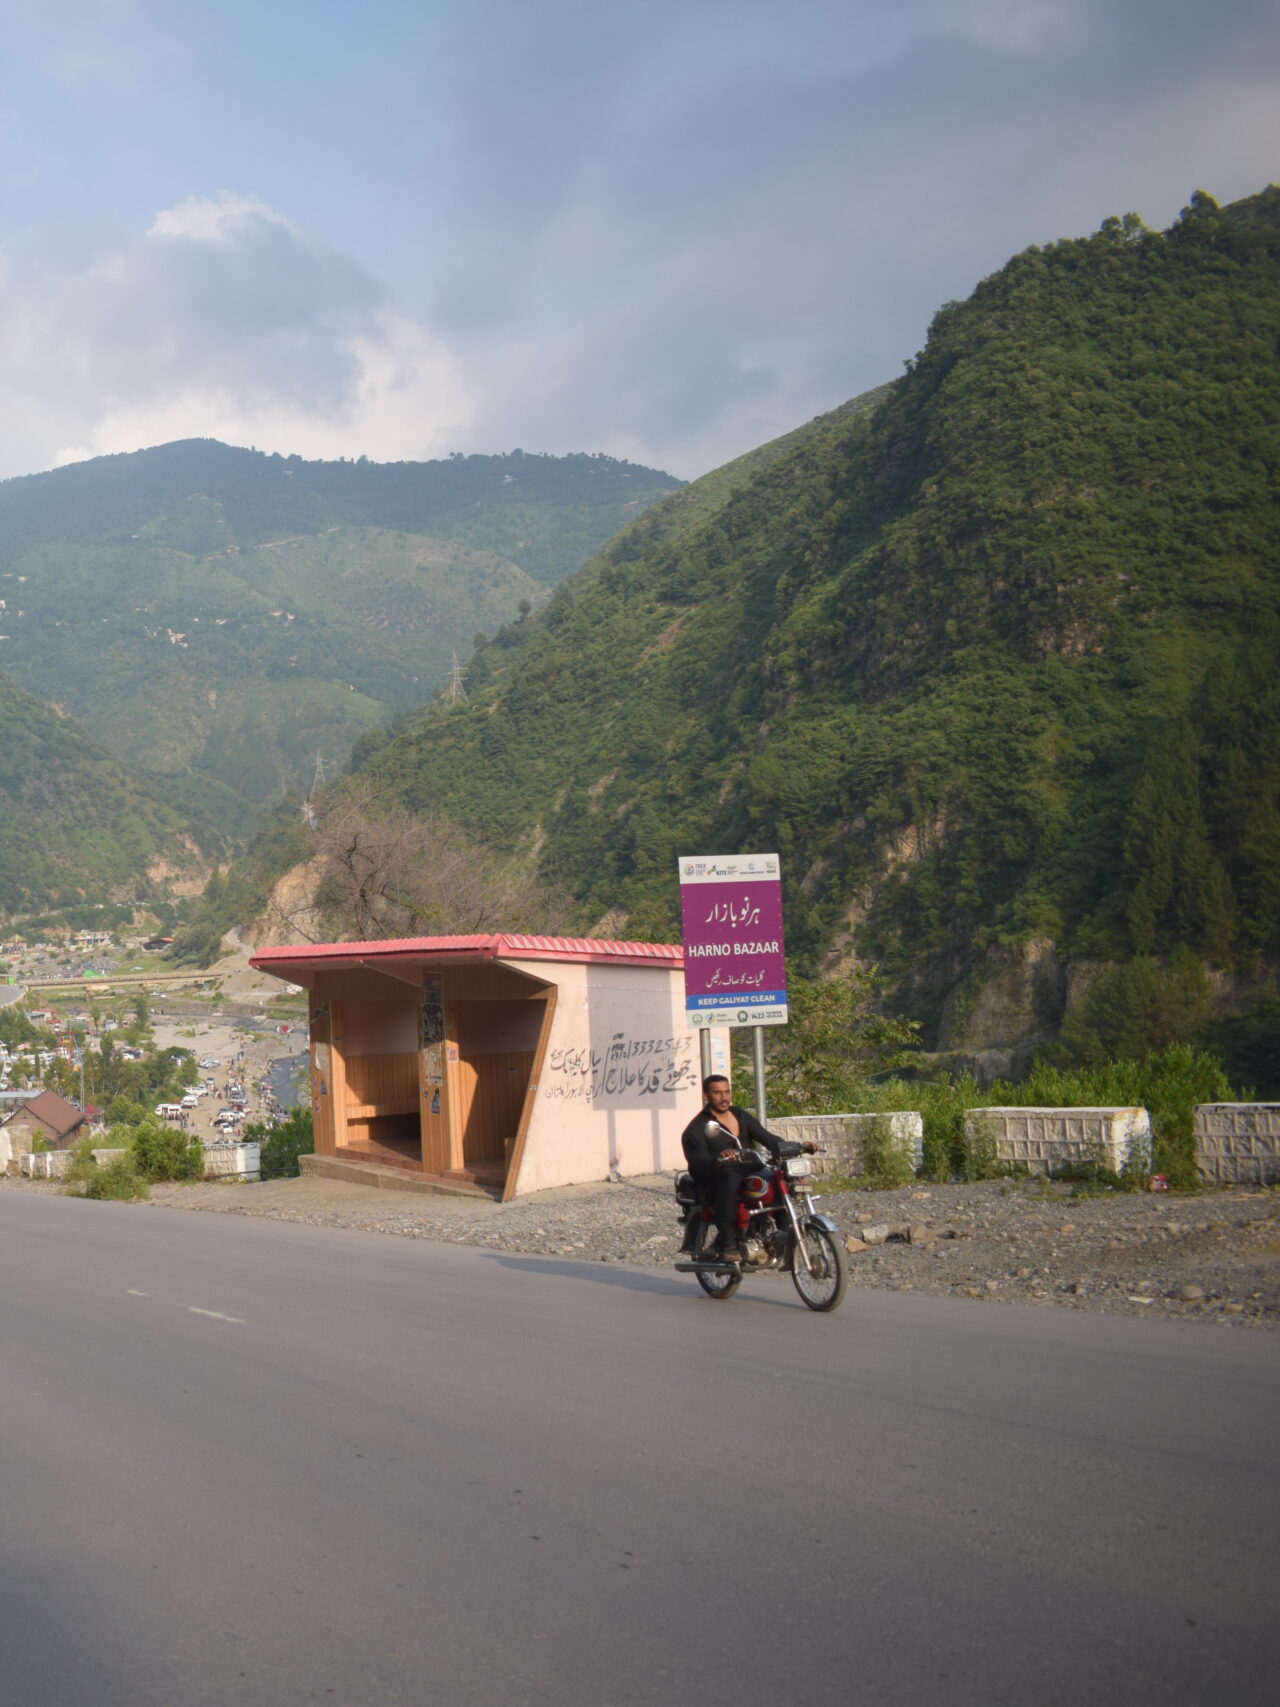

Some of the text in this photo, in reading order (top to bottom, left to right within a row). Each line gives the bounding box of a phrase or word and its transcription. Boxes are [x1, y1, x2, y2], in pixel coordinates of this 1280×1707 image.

[705, 896, 761, 928] ہرنو بازار
[688, 941, 779, 958] HARNO BAZAAR
[698, 994, 776, 1006] KEEP GALIYAT CLEAN
